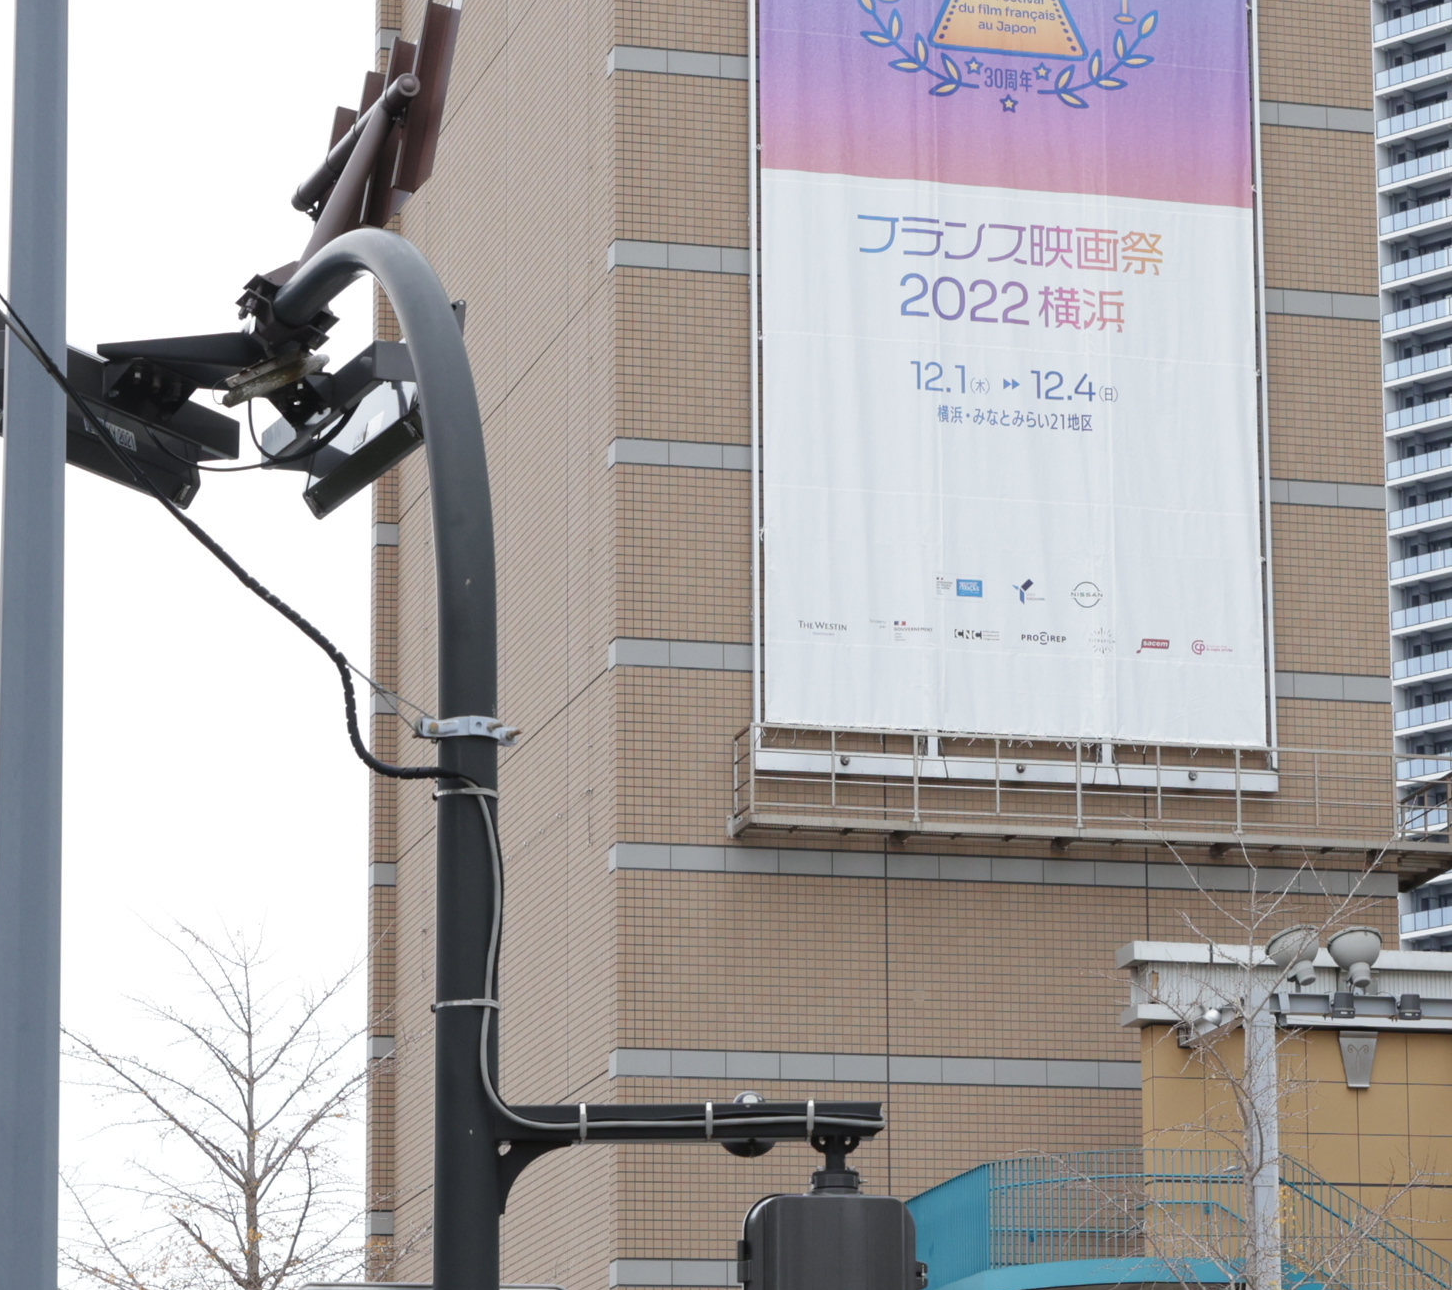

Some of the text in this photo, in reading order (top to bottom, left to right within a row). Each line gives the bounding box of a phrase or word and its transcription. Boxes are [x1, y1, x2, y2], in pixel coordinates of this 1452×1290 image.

[958, 2, 1056, 23] du film français
[978, 19, 1037, 36] au Japon
[984, 67, 1033, 92] 30周年
[857, 214, 1163, 275] フランス映画祭
[900, 273, 1125, 333] 2022 横浜
[937, 405, 1093, 432] 横浜・みなとみらい21地区
[798, 620, 847, 631] THE WESTIN
[1021, 633, 1067, 644] PROCIREP
[1143, 640, 1168, 648] sacem
